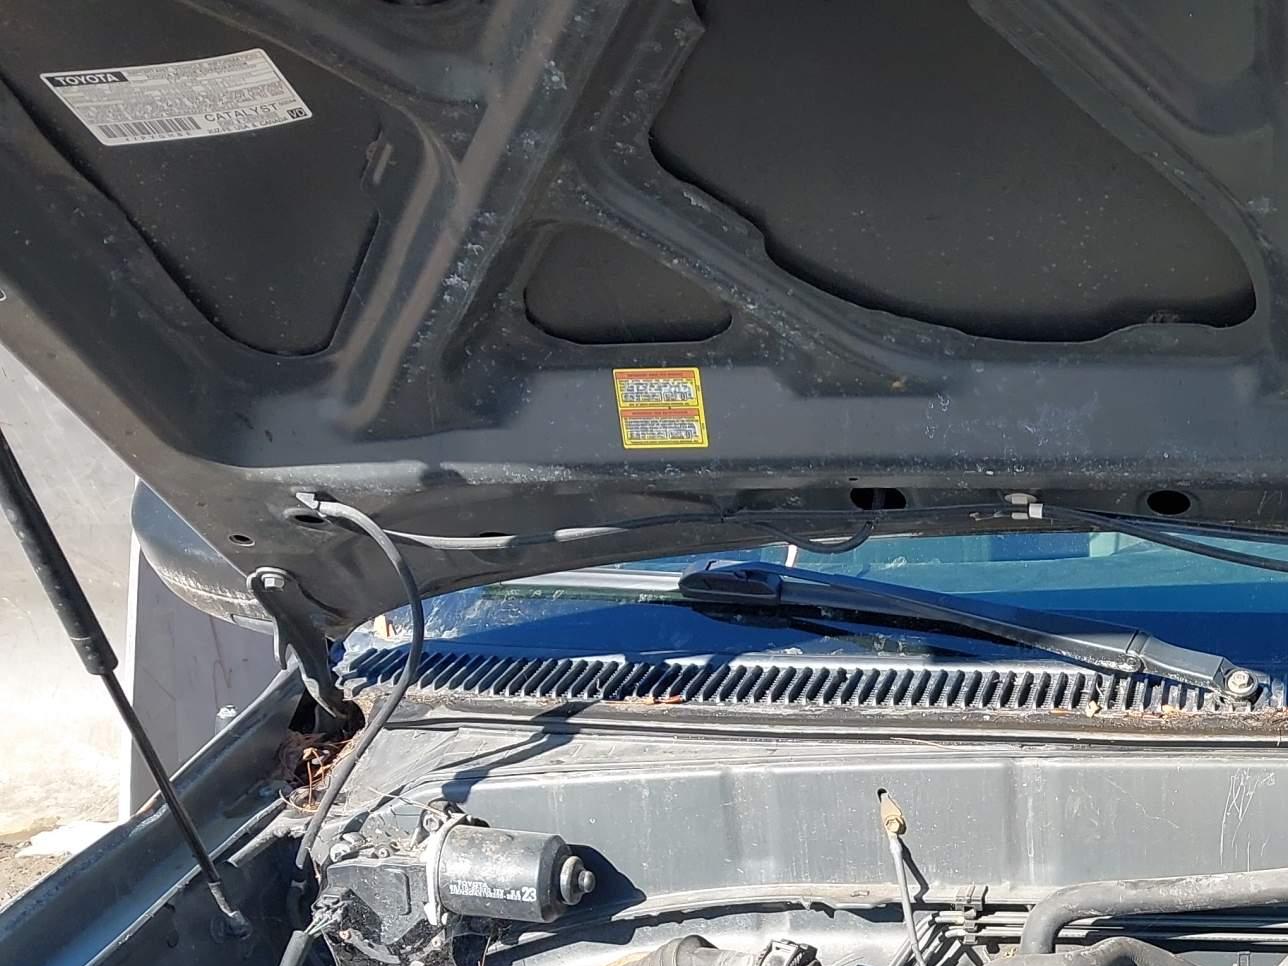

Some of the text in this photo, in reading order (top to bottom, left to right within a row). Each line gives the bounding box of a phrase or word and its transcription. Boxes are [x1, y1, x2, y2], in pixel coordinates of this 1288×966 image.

[54, 73, 120, 86] TOYOTA
[204, 102, 280, 122] CATALYST
[288, 107, 307, 120] VD
[521, 886, 538, 902] 23
